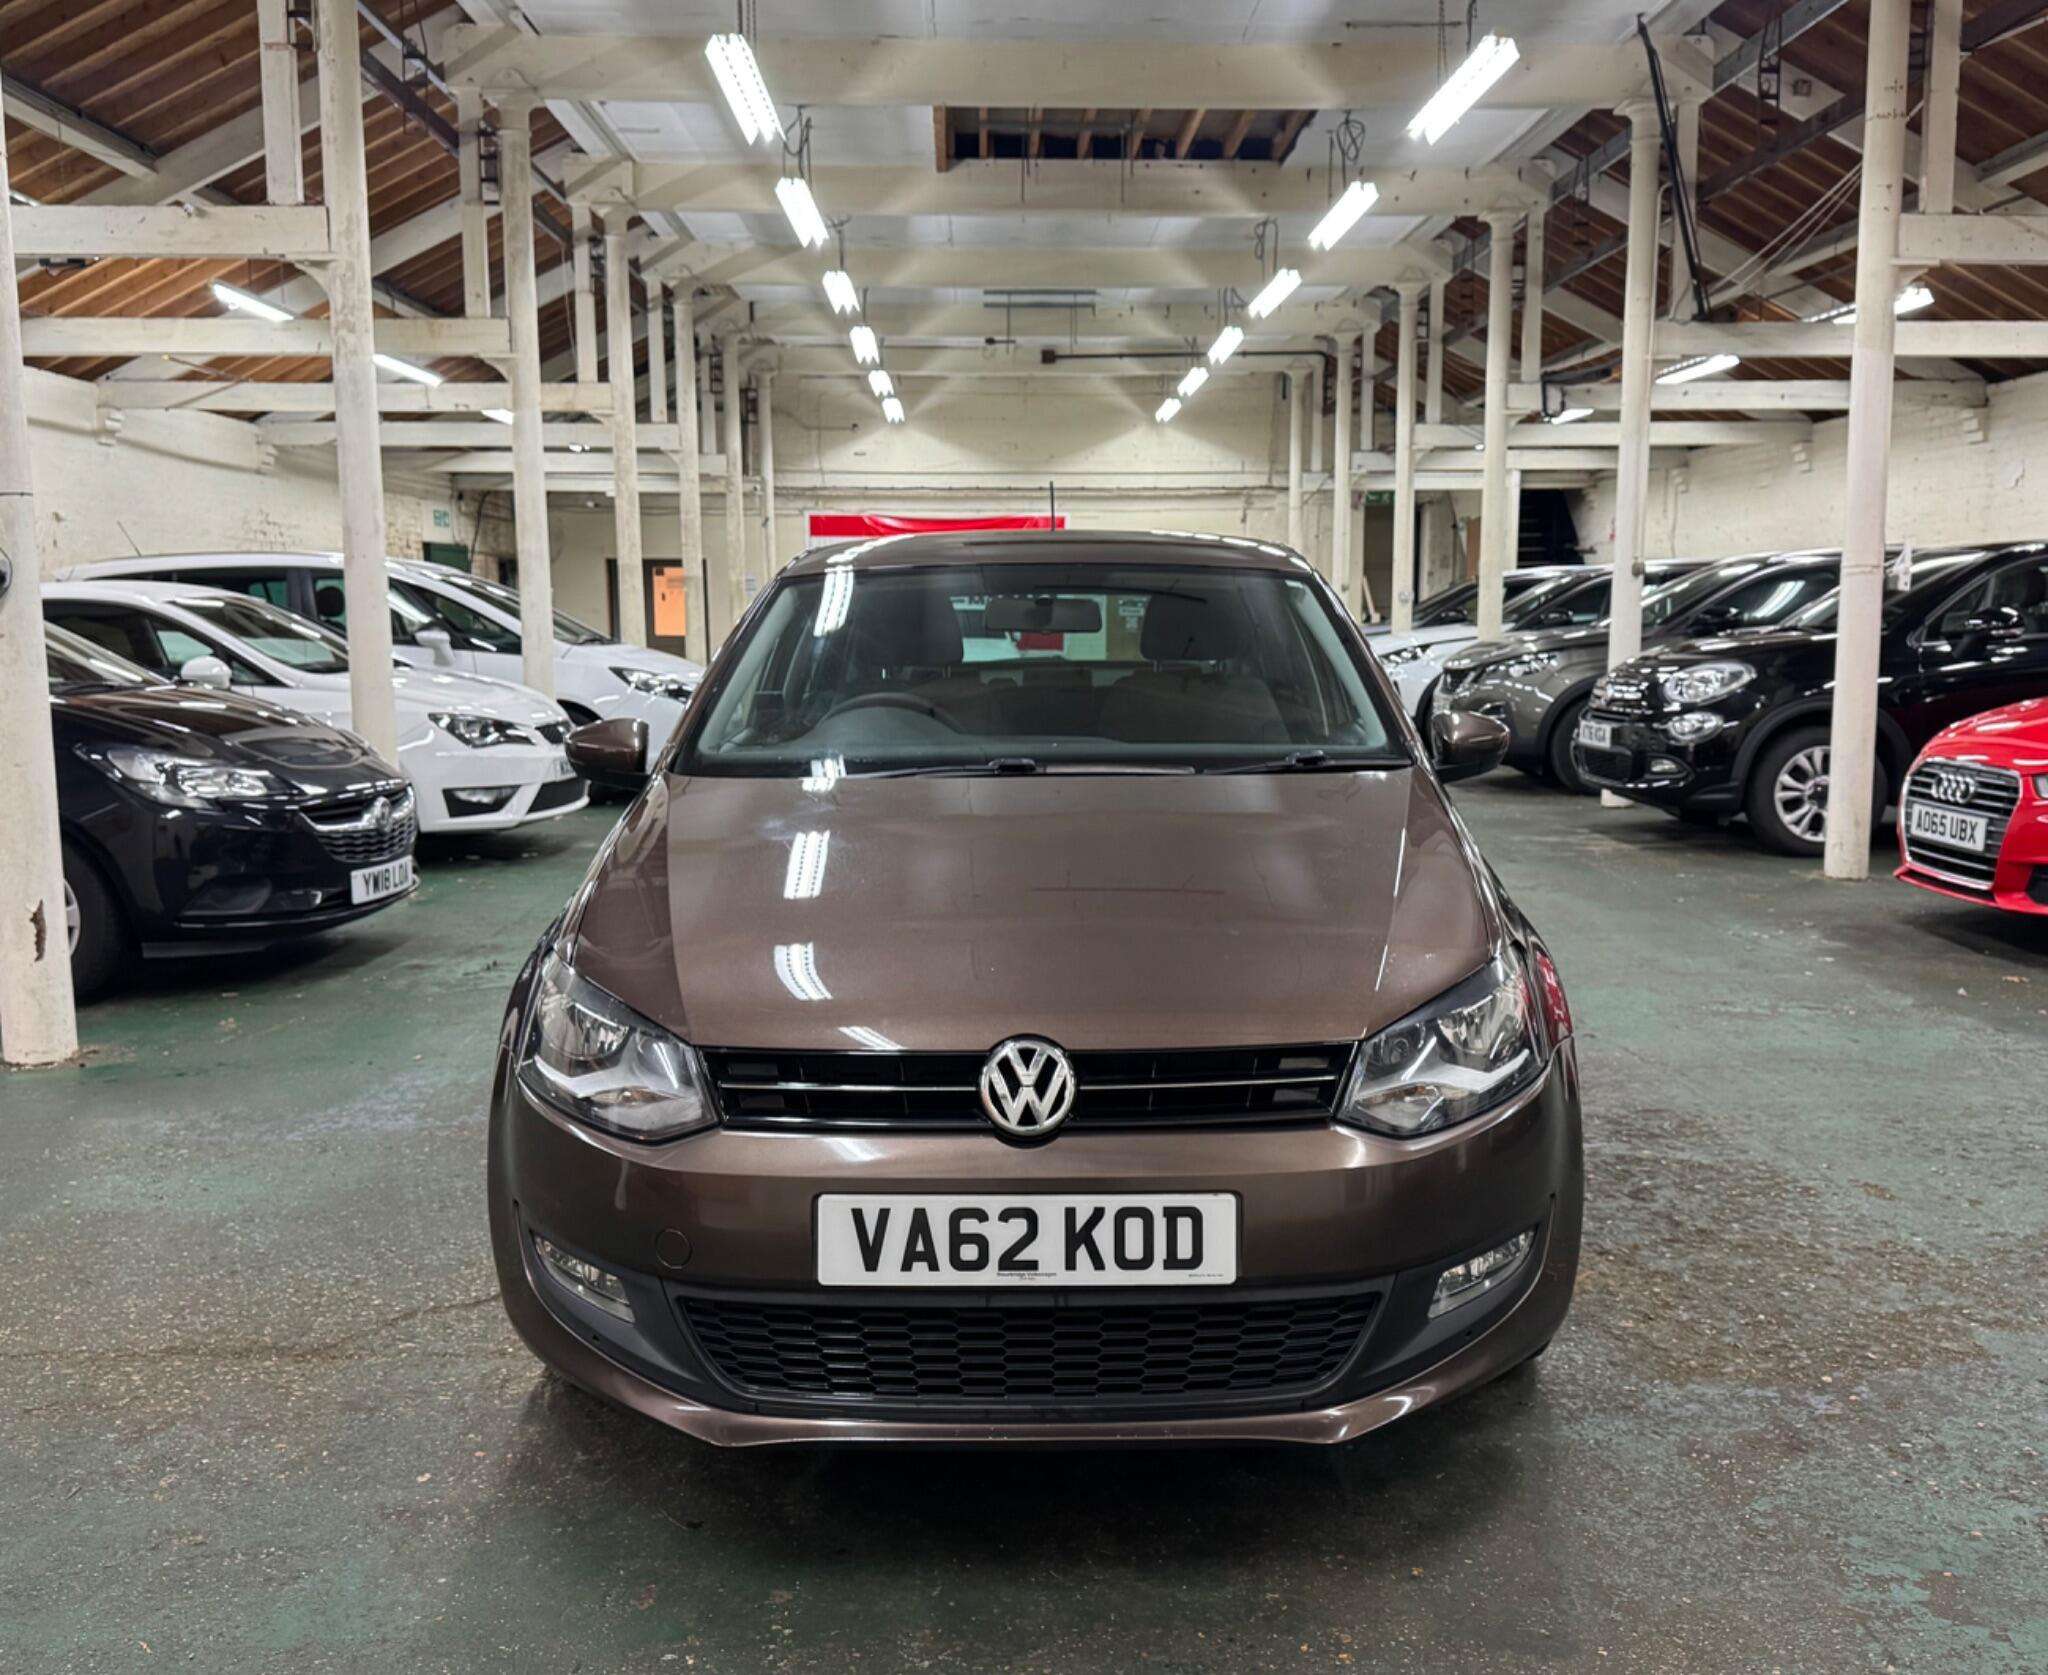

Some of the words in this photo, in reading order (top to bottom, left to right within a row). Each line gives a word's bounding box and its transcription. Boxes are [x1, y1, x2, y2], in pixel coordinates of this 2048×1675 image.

[1949, 815, 1979, 845] UBX
[851, 1206, 1040, 1273] VA62
[1064, 1206, 1204, 1272] KOD
